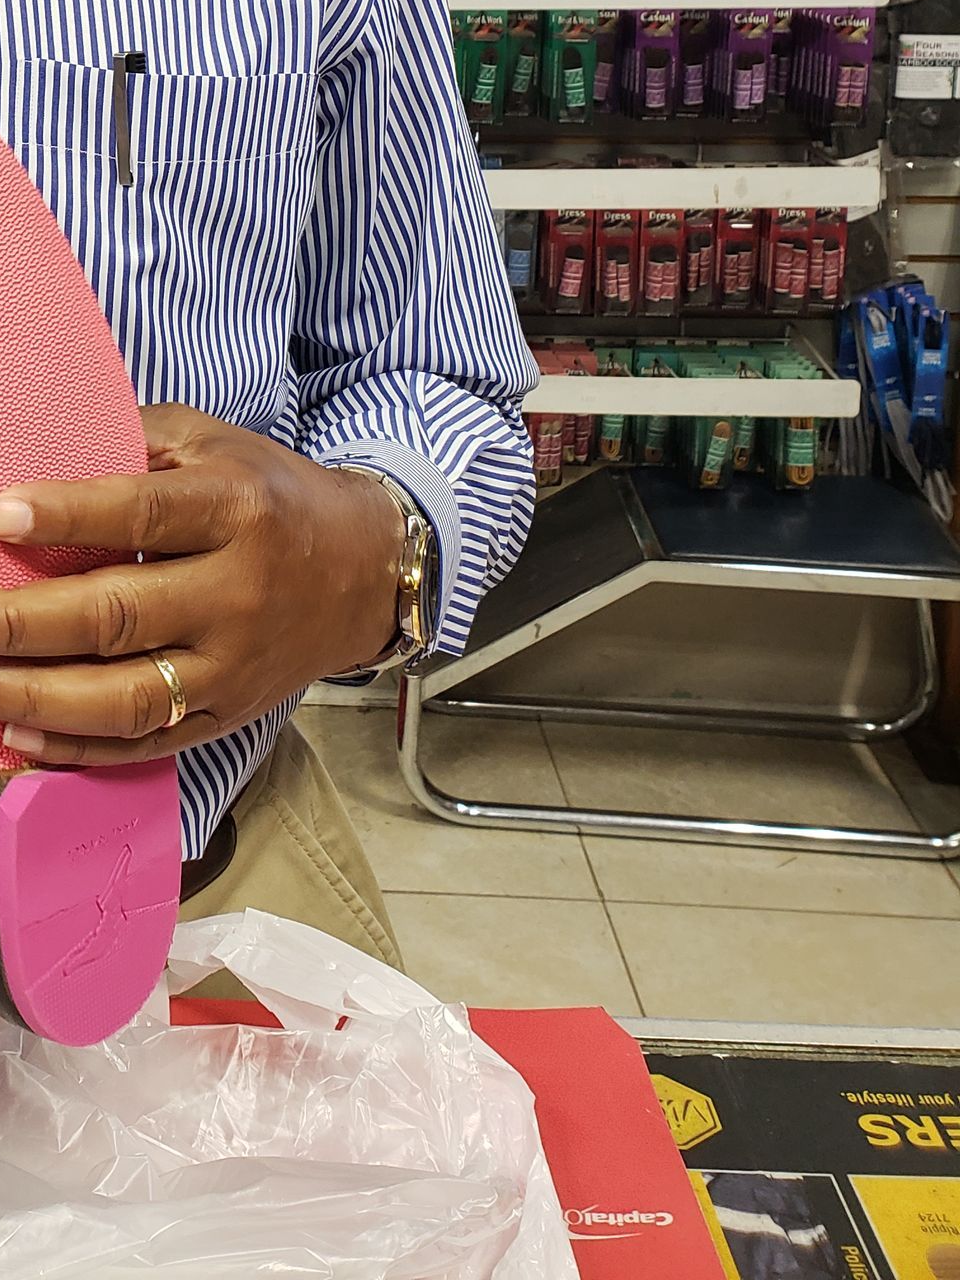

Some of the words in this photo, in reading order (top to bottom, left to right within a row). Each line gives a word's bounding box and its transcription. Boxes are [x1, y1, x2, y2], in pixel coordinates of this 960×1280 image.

[641, 10, 675, 23] Casual
[735, 12, 769, 25] Casual
[834, 15, 870, 28] Casual
[604, 211, 632, 222] Dress
[649, 211, 677, 222] Dress
[778, 207, 807, 218] Dress
[840, 1091, 917, 1109] lifestyle.
[918, 1094, 955, 1110] your
[858, 1112, 960, 1149] ERS
[918, 1212, 949, 1223] 7124
[920, 1224, 960, 1237] Ripple
